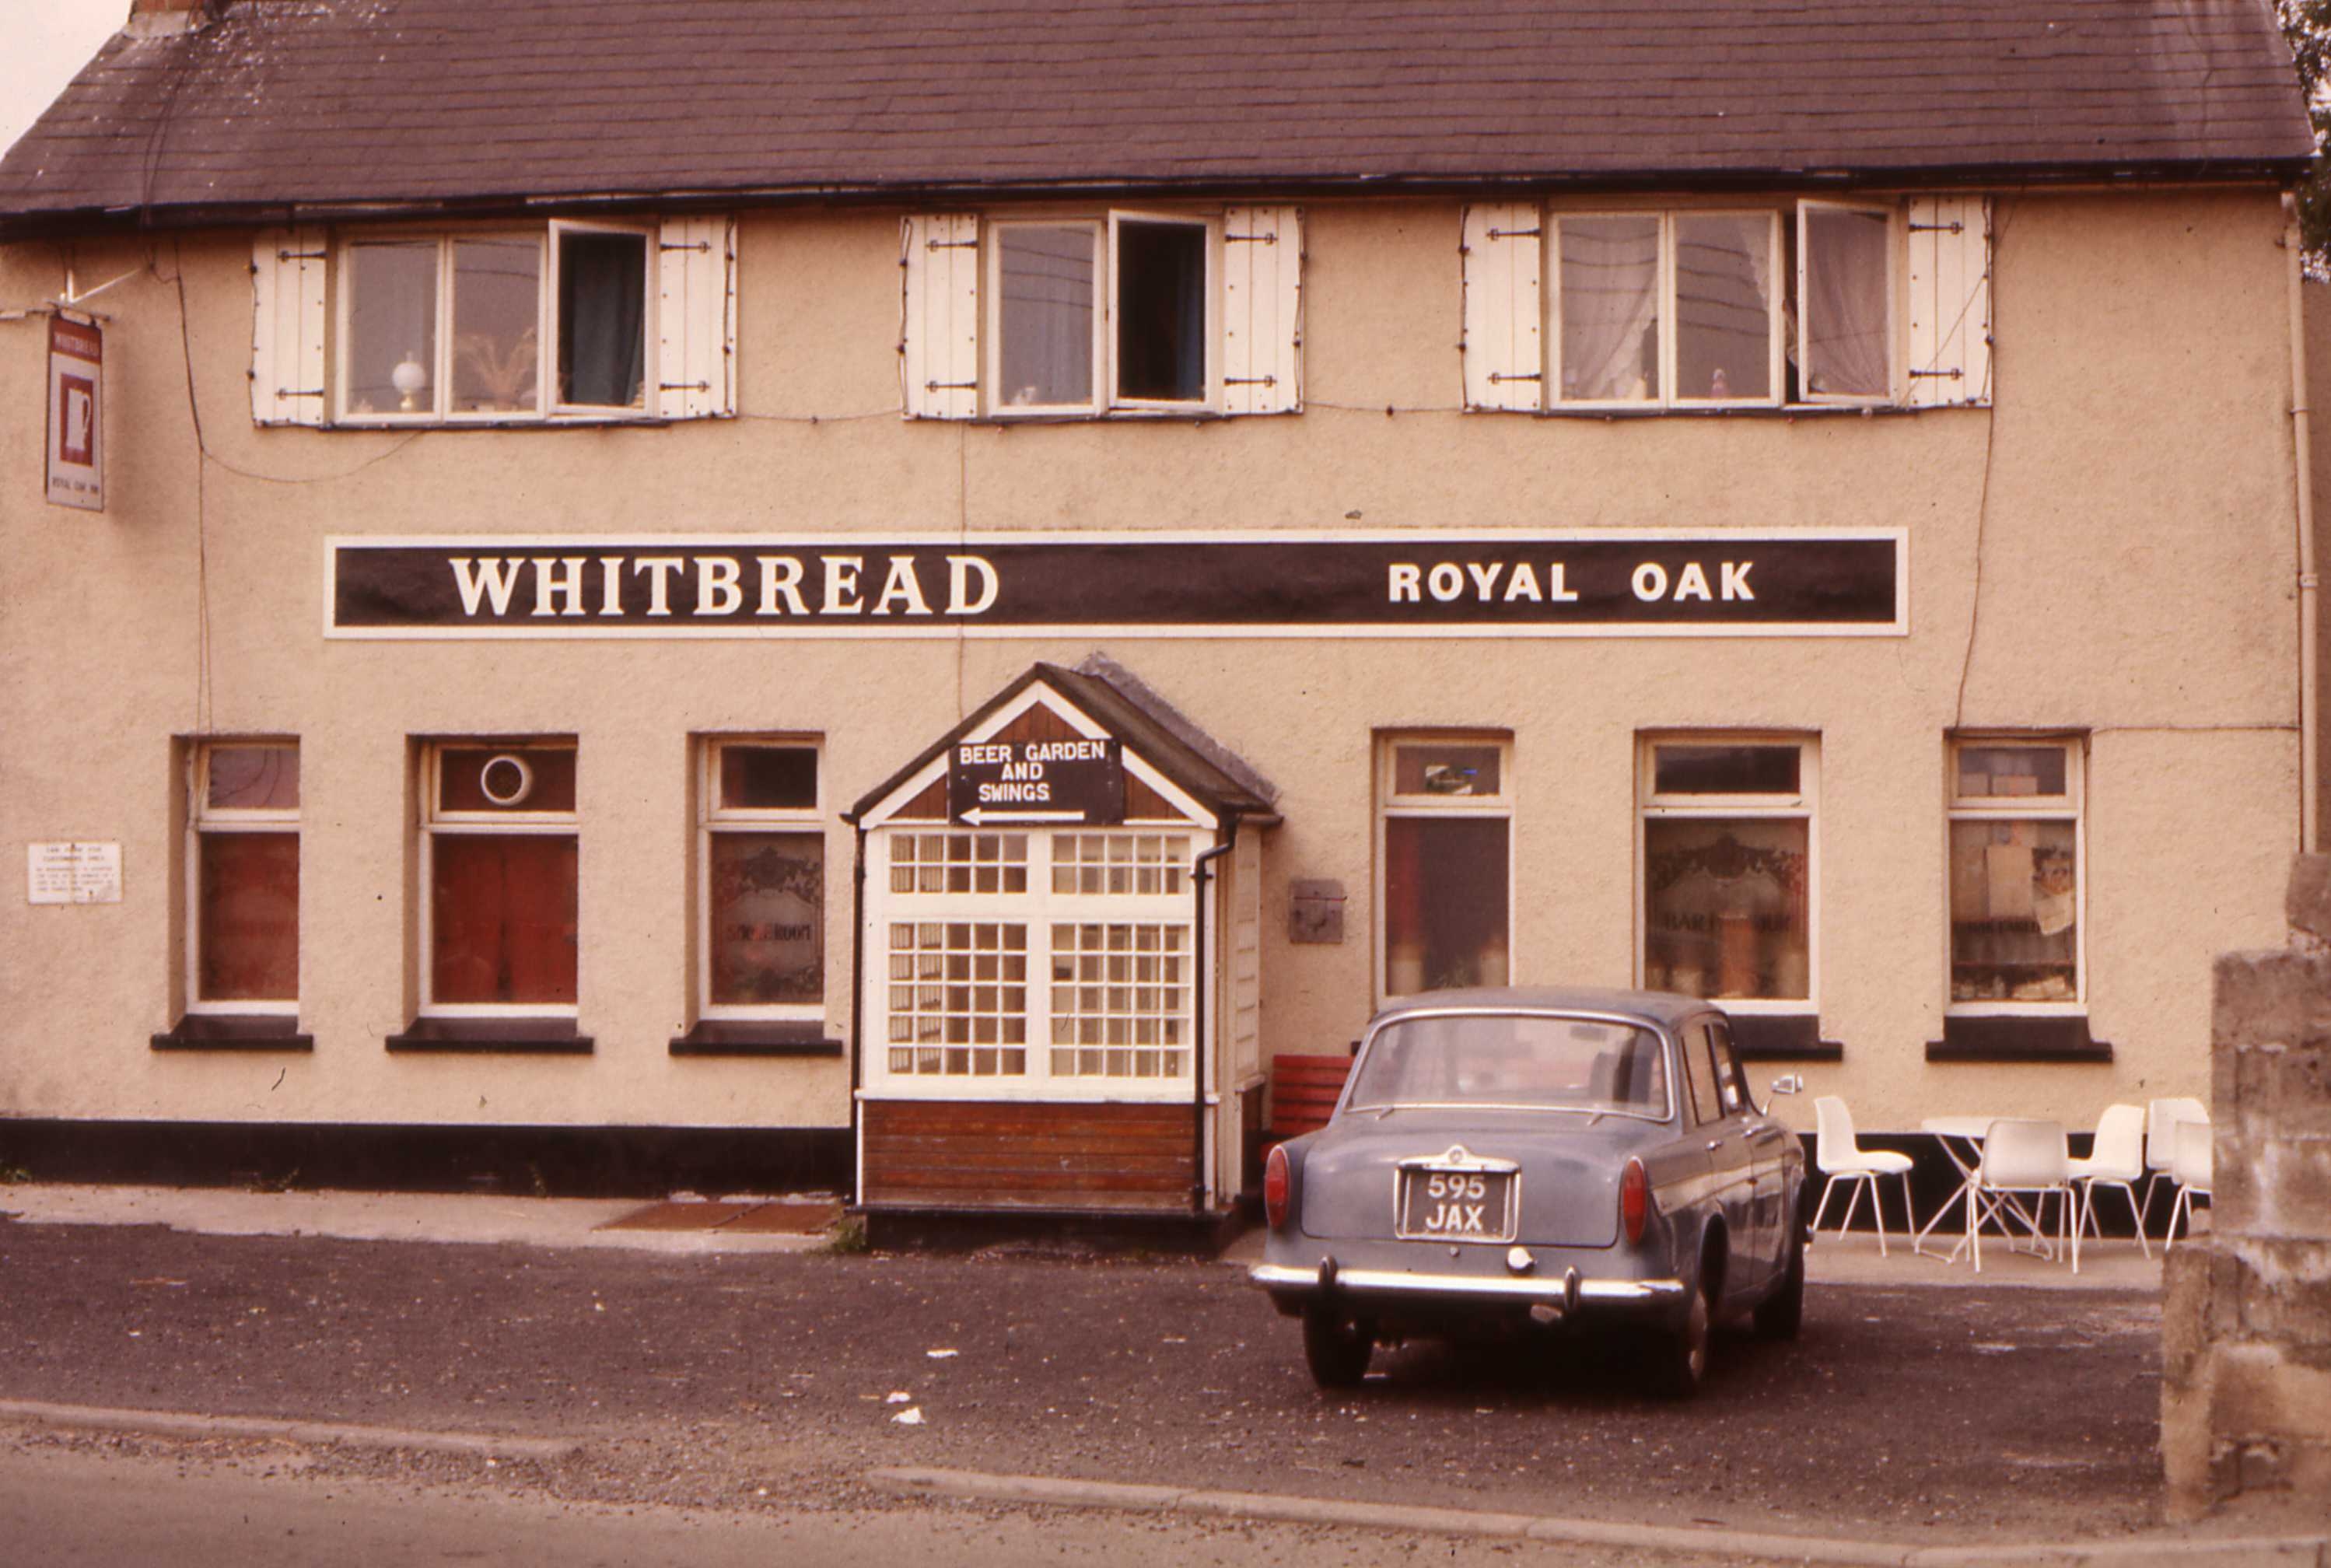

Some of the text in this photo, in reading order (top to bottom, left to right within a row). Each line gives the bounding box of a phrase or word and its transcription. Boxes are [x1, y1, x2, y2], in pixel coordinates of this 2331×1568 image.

[449, 555, 1756, 617] WHITBREAD ROYAL OAK
[959, 741, 1106, 765] BEER GARDEN
[1001, 762, 1044, 781] AND
[978, 782, 1051, 803] SWINGS
[1428, 1174, 1486, 1199] 595
[1426, 1202, 1485, 1233] JAX
